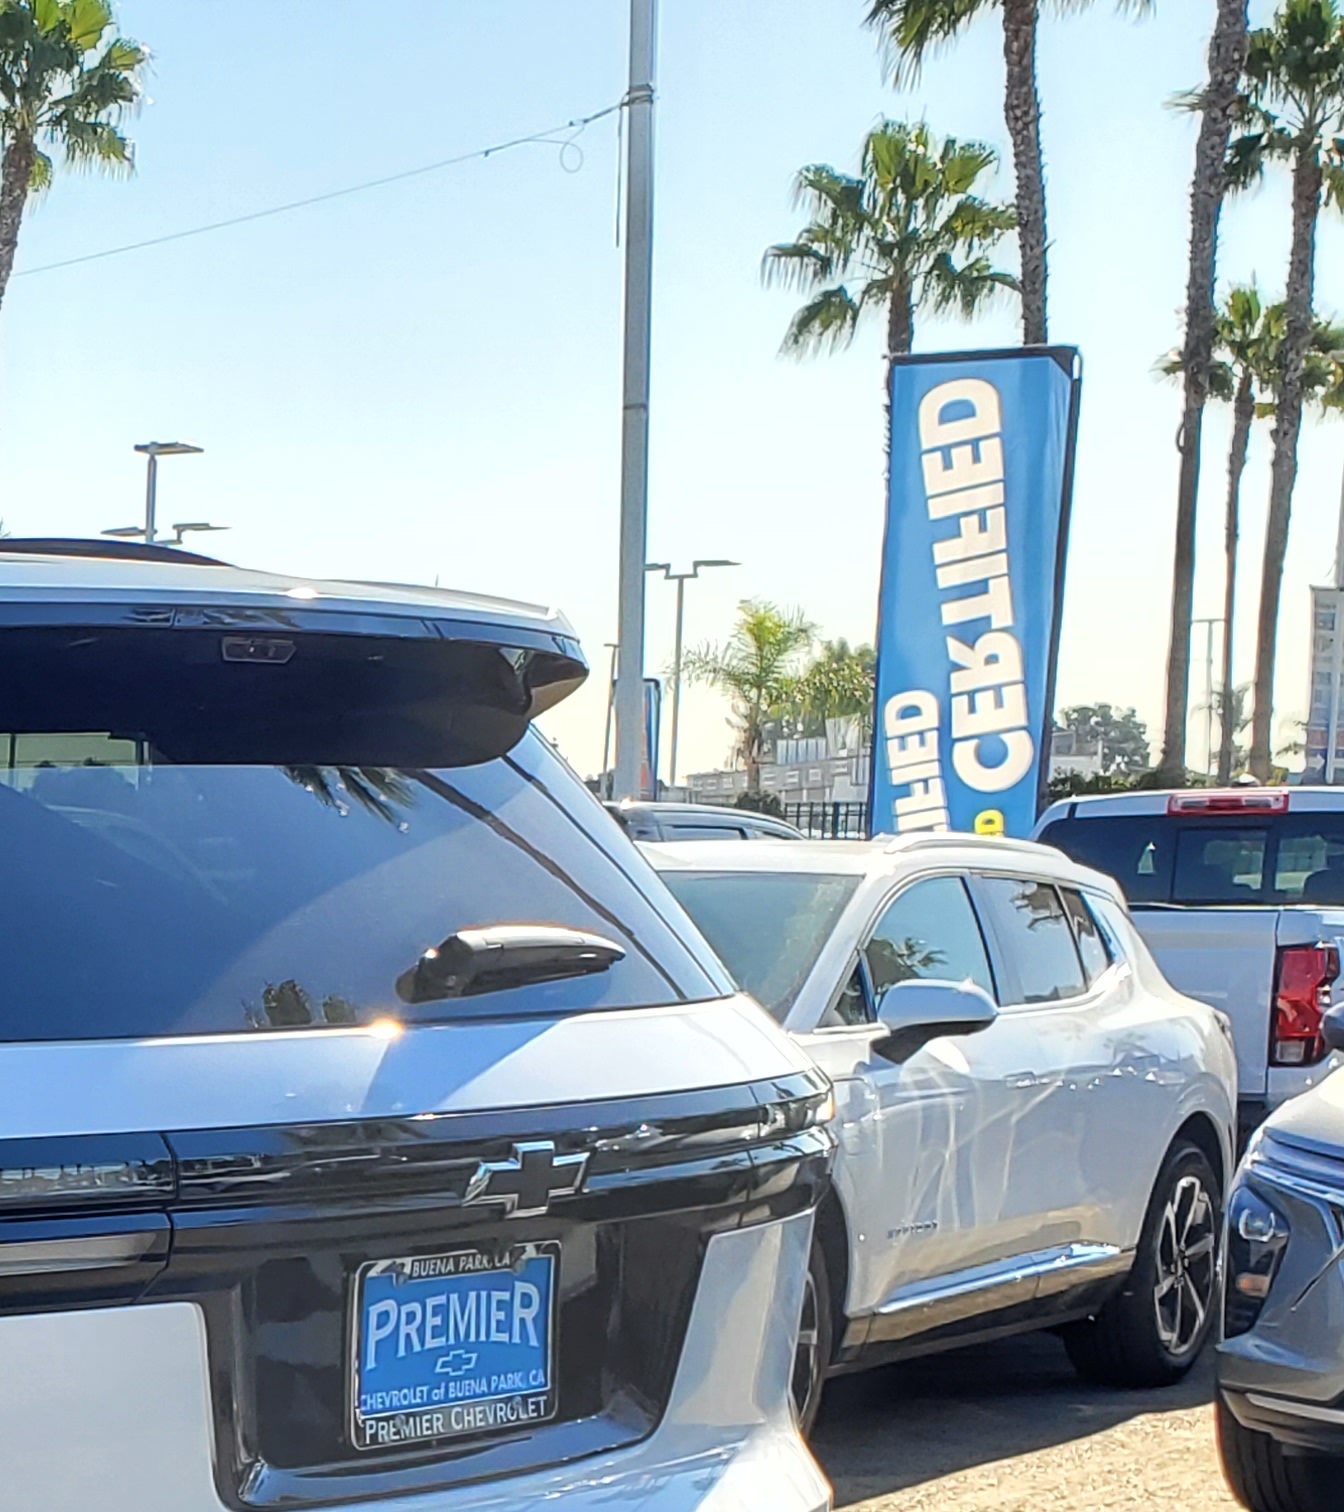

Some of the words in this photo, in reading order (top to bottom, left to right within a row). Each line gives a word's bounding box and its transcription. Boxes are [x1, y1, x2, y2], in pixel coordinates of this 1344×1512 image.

[411, 1258, 455, 1278] BUENA
[365, 1281, 541, 1373] PREMIER
[360, 1385, 429, 1411] CHEVROLET
[432, 1382, 446, 1401] of
[449, 1377, 488, 1398] BUENA
[529, 1369, 546, 1386] CA
[365, 1411, 444, 1444] PREMIER
[451, 1395, 548, 1430] CHEVROLET
